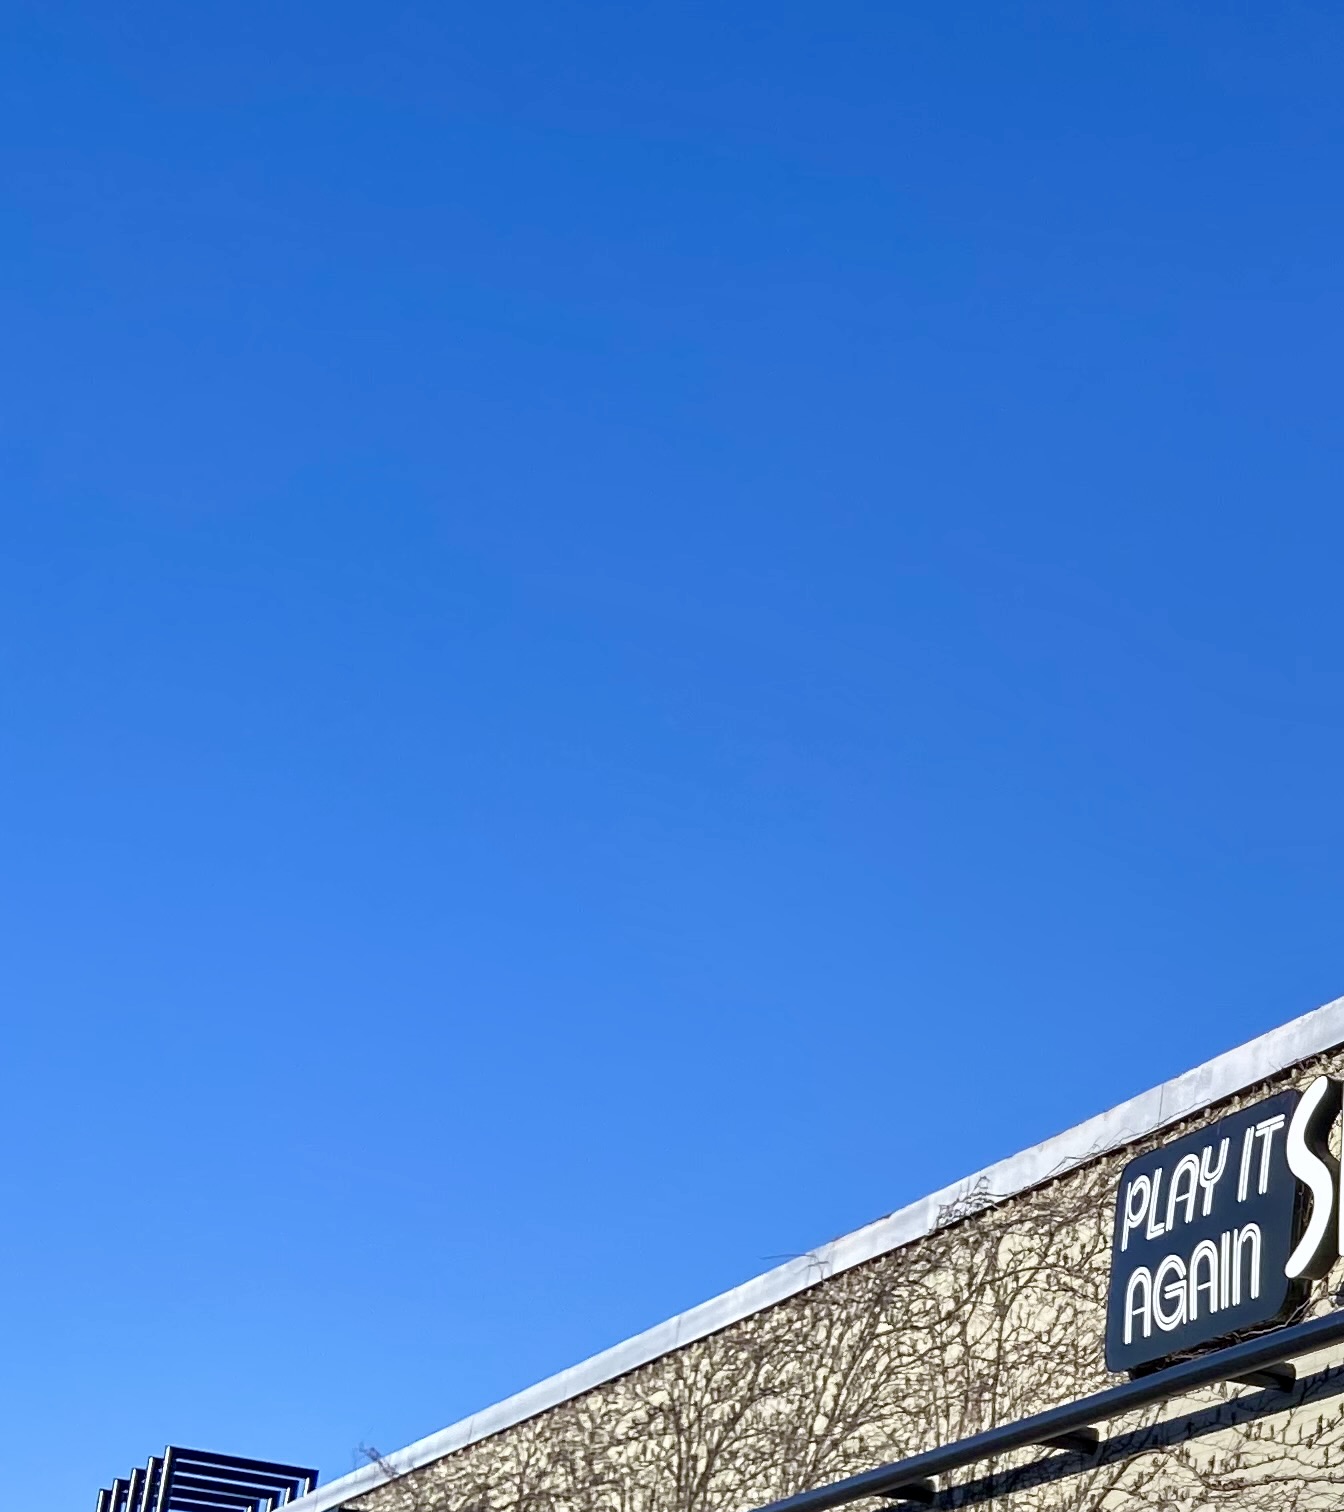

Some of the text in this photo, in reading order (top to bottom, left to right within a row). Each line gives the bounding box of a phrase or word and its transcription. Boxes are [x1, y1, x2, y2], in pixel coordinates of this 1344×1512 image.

[1121, 1114, 1286, 1252] PLAY IT
[1124, 1222, 1262, 1345] AGAIN
